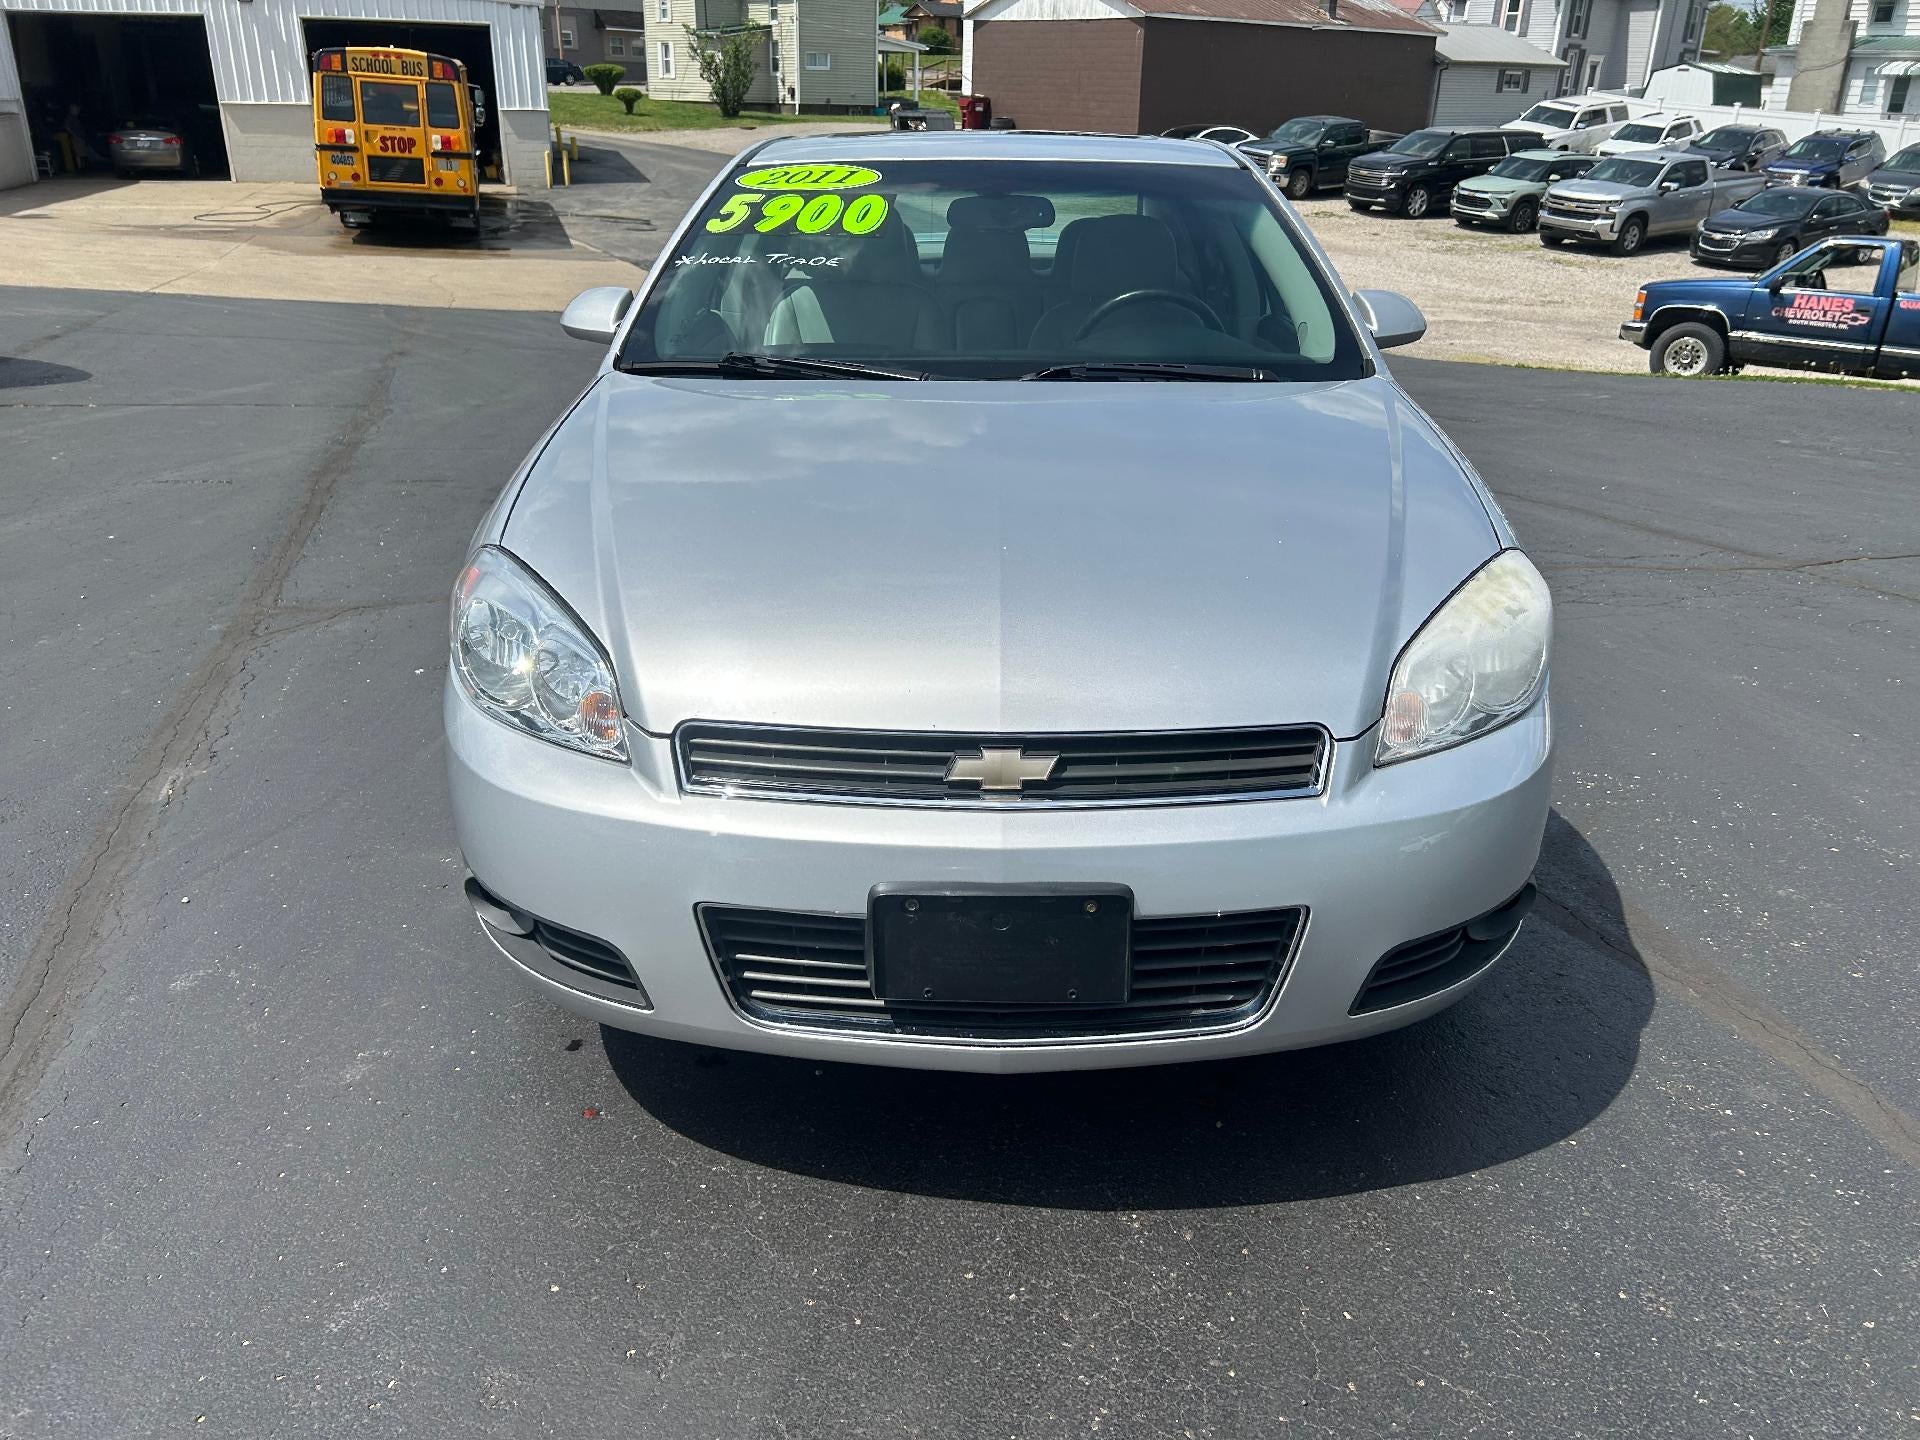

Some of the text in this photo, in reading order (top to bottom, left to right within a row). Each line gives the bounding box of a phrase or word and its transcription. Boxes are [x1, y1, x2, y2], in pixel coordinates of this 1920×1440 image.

[351, 56, 423, 76] SCHOOL BUS
[379, 135, 416, 154] STOP
[446, 160, 453, 171] 13
[757, 169, 861, 184] 2011
[705, 193, 889, 235] 5900
[1793, 294, 1855, 313] HANES
[1771, 306, 1843, 322] CHEVROLET
